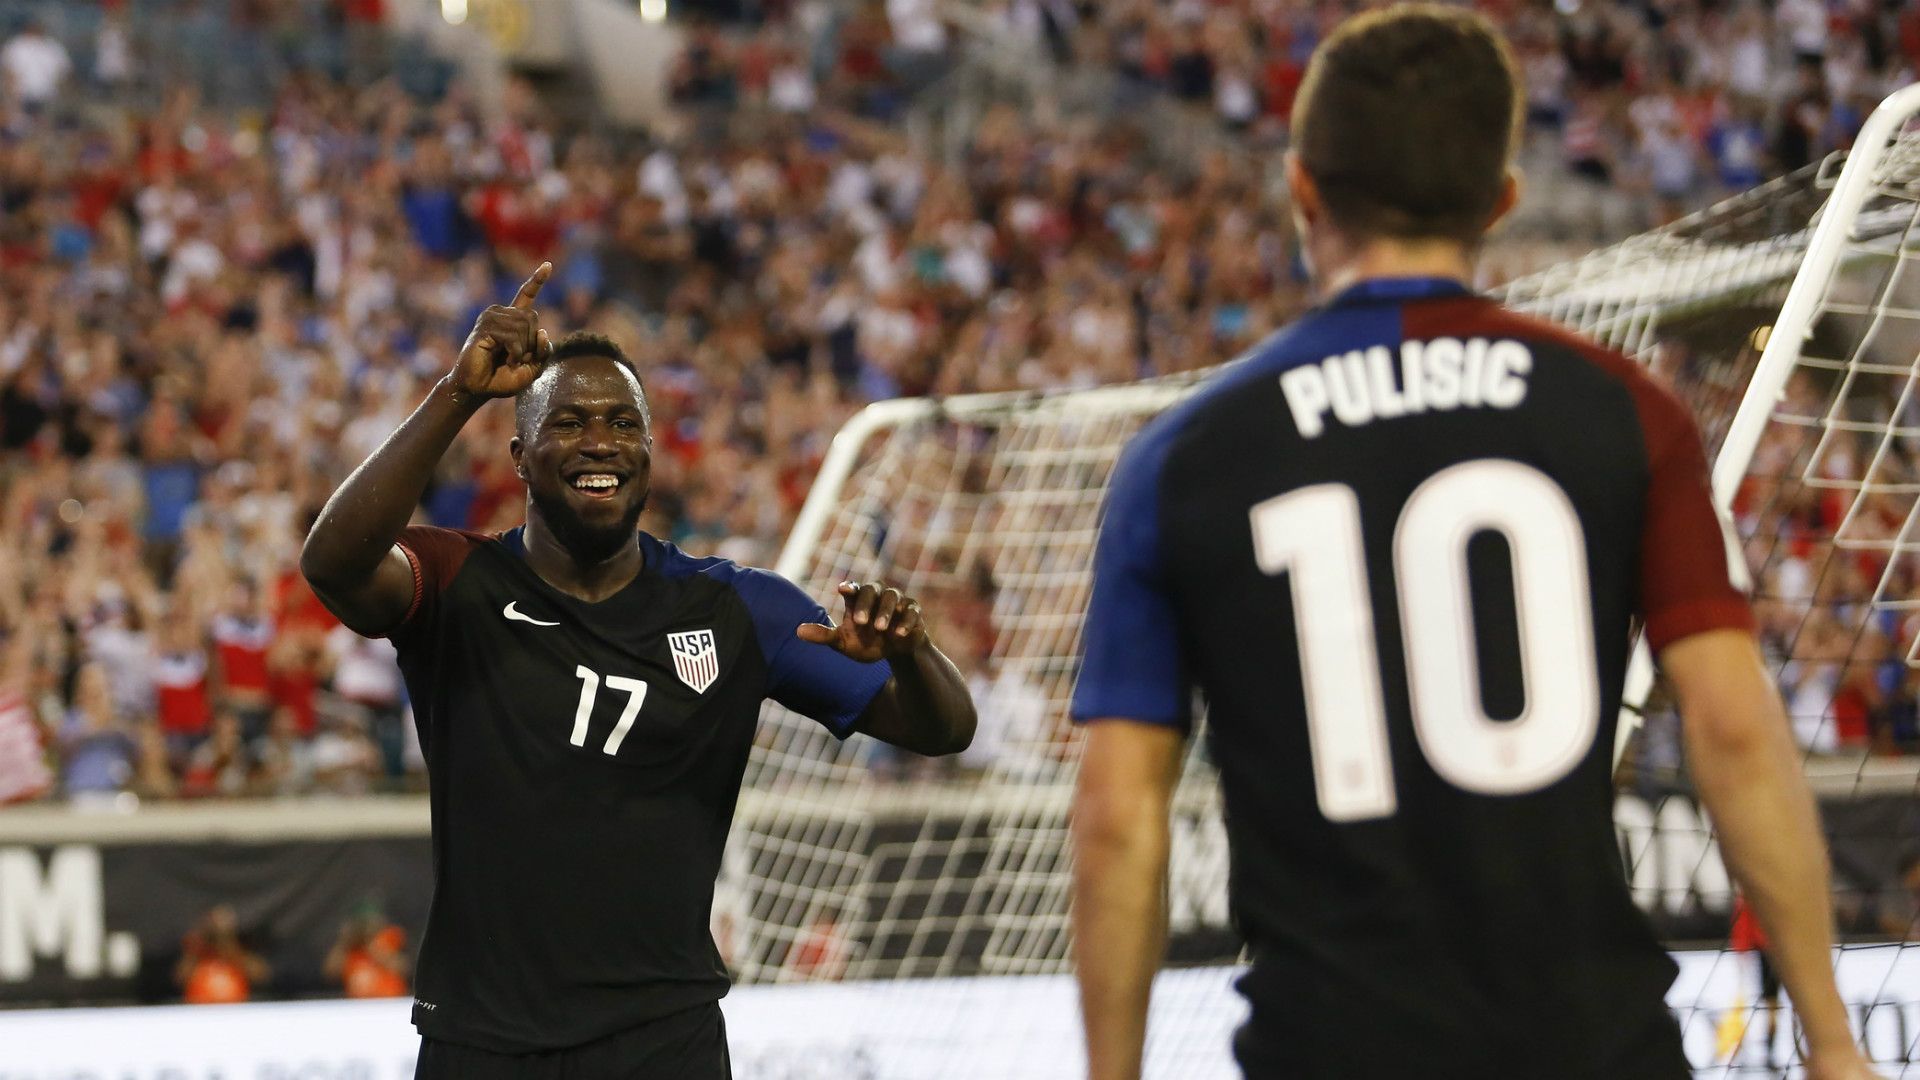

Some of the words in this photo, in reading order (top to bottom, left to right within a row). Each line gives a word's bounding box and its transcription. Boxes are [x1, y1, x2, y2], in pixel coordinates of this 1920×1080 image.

[1279, 335, 1534, 440] PULISIC
[671, 632, 712, 657] USA
[1249, 457, 1602, 824] 10
[570, 664, 648, 757] 17
